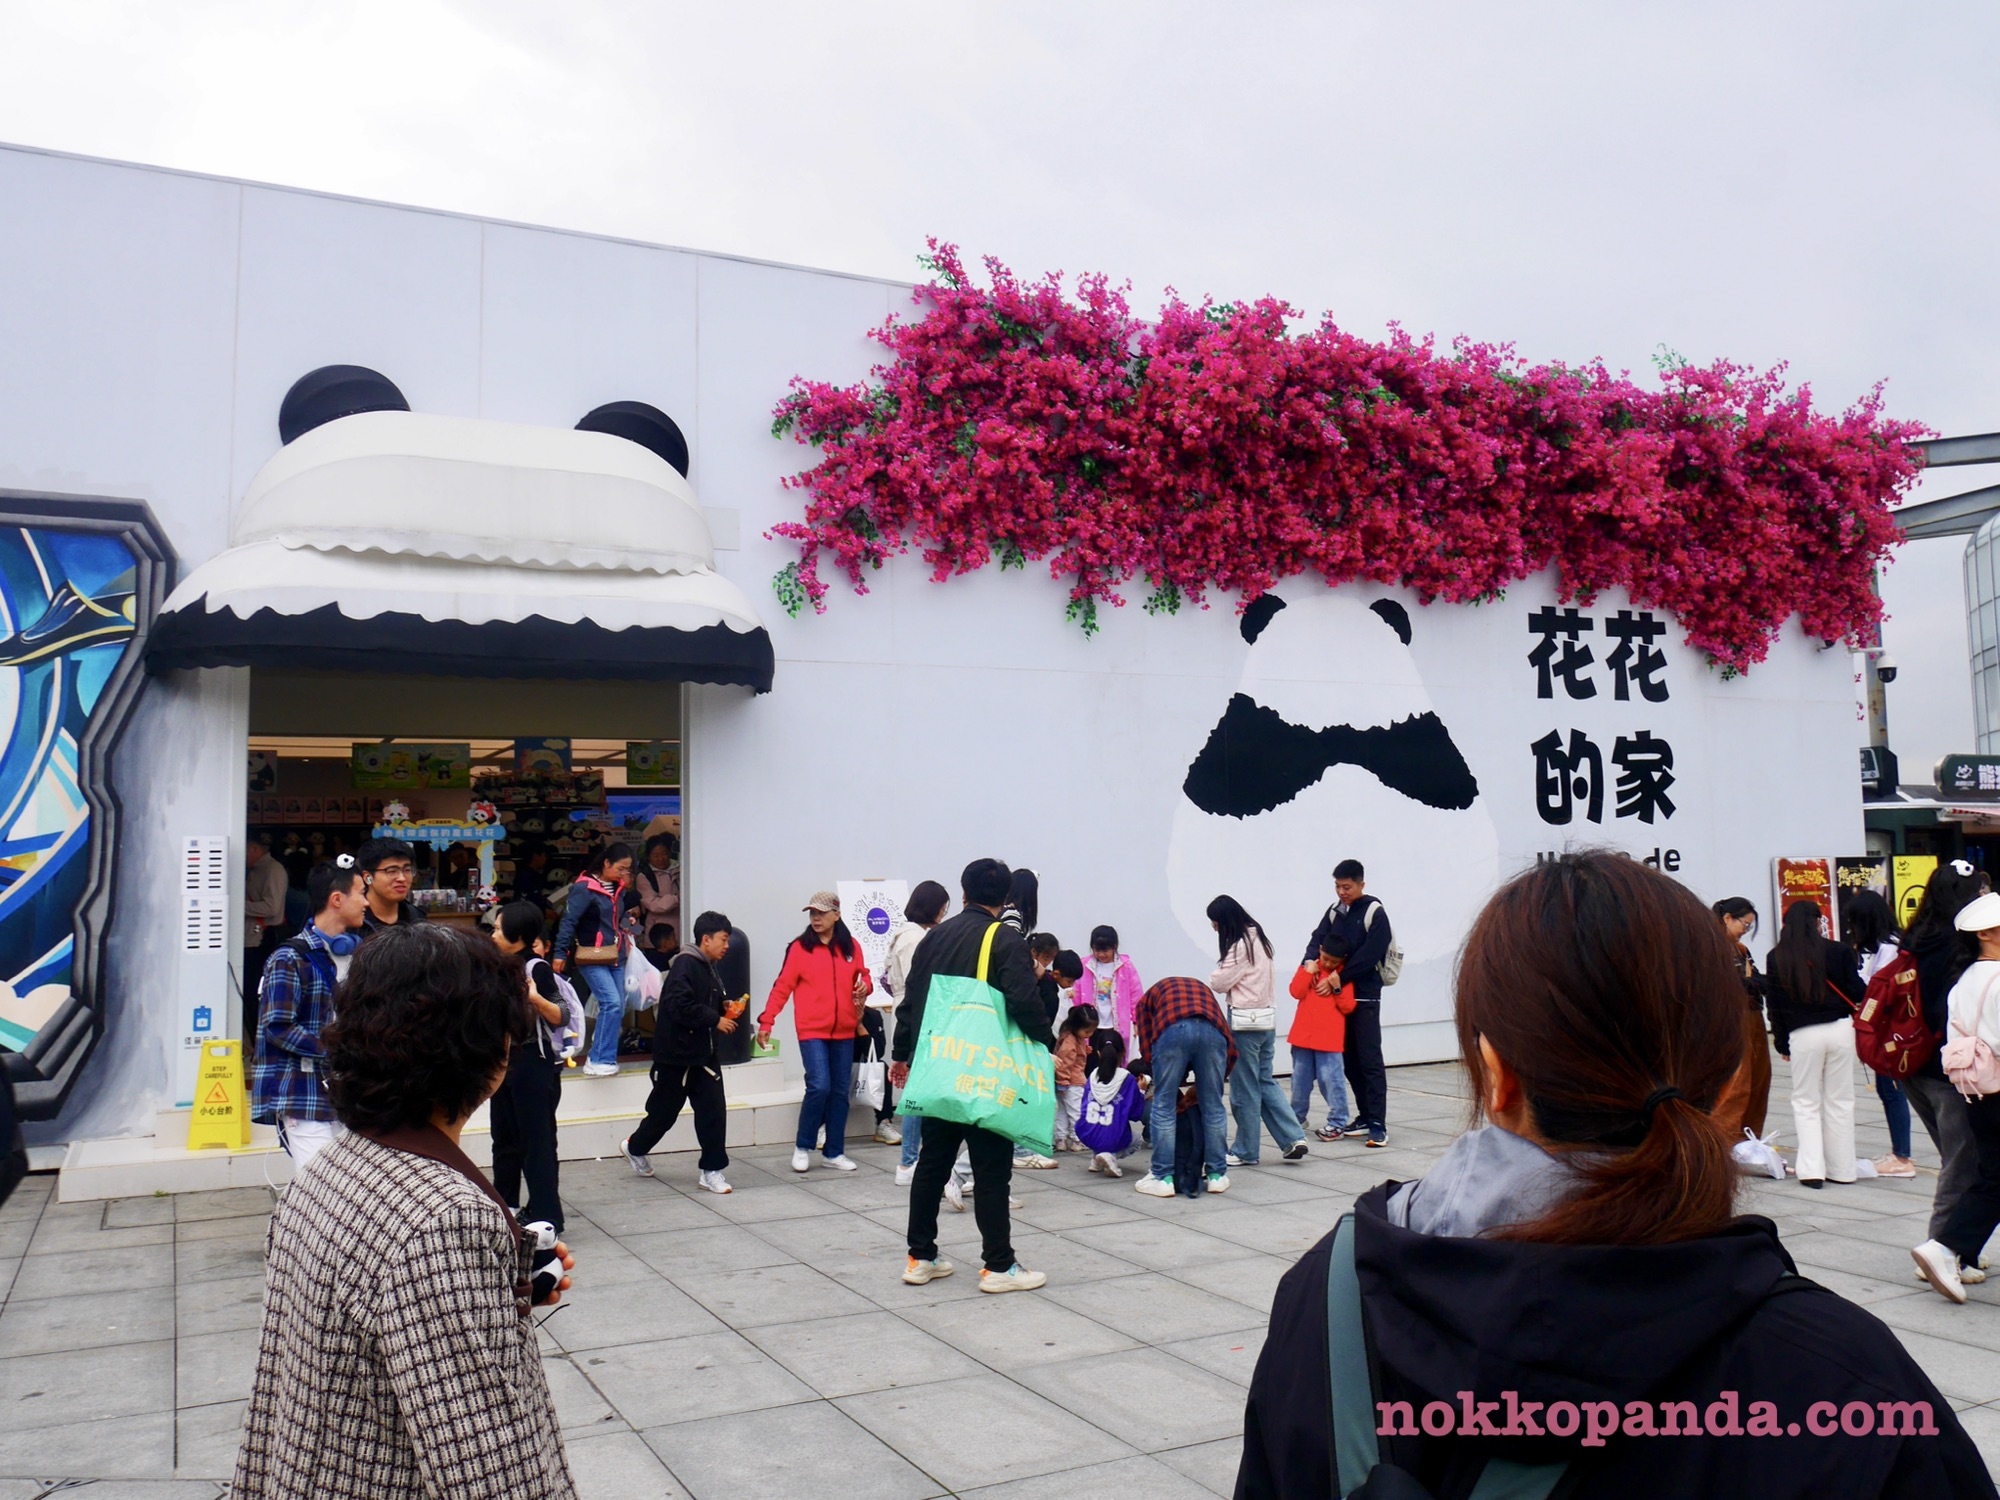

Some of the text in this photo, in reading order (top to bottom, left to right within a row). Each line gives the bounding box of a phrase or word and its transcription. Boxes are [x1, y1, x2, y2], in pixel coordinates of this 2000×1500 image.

[1527, 605, 1670, 703] 花花
[1530, 728, 1677, 826] 的家
[930, 1035, 982, 1067] TNT
[200, 1106, 233, 1116] 小心台阶
[1085, 1101, 1114, 1126] 63
